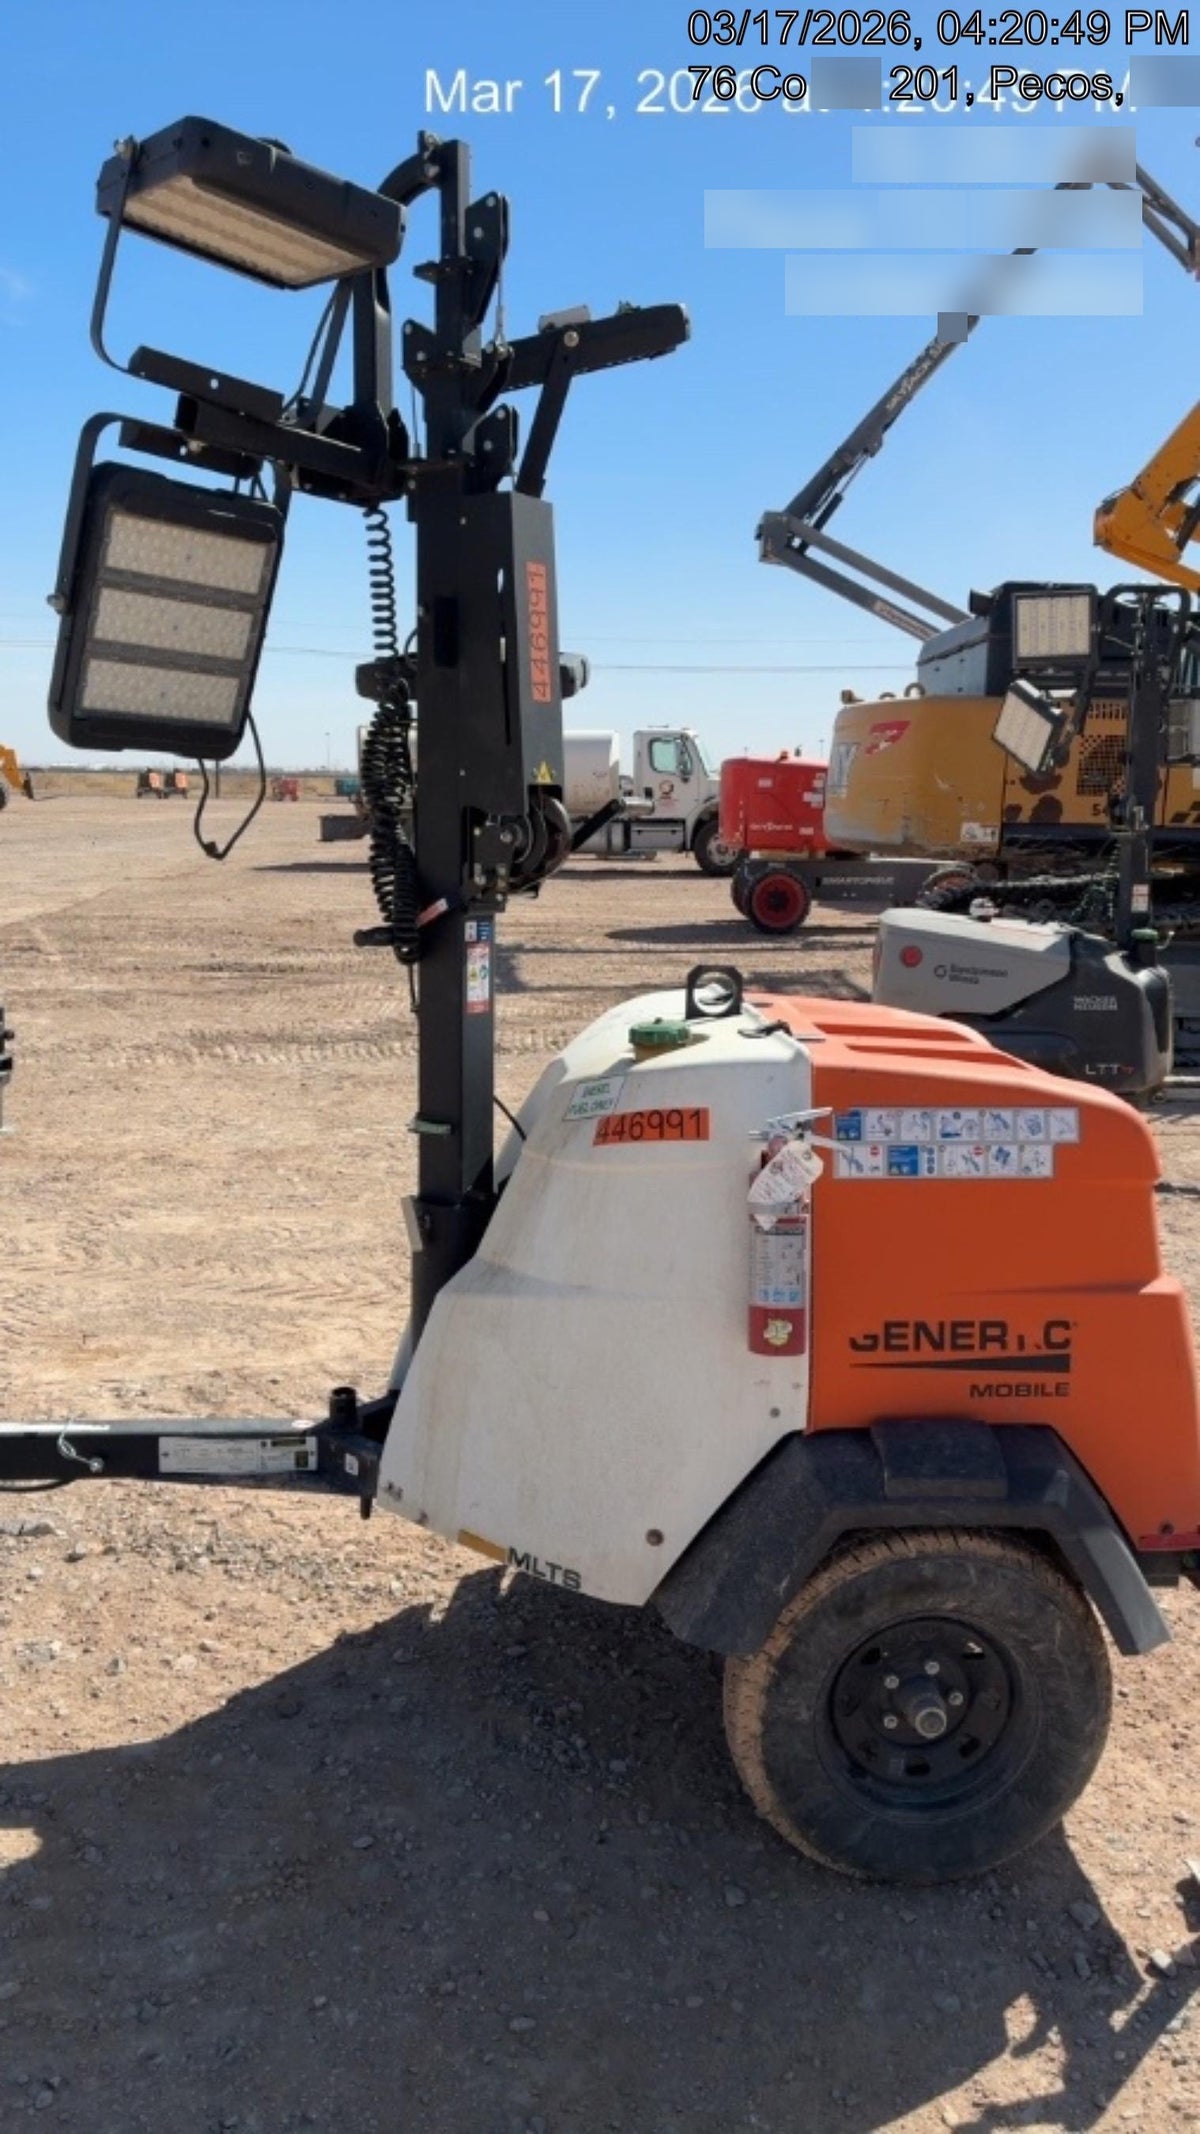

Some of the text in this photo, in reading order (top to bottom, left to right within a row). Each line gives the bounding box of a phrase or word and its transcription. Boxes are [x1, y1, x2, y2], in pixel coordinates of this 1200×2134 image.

[596, 1109, 702, 1143] 446991
[970, 1382, 1070, 1398] MOBILE
[508, 1546, 581, 1591] MLTS
